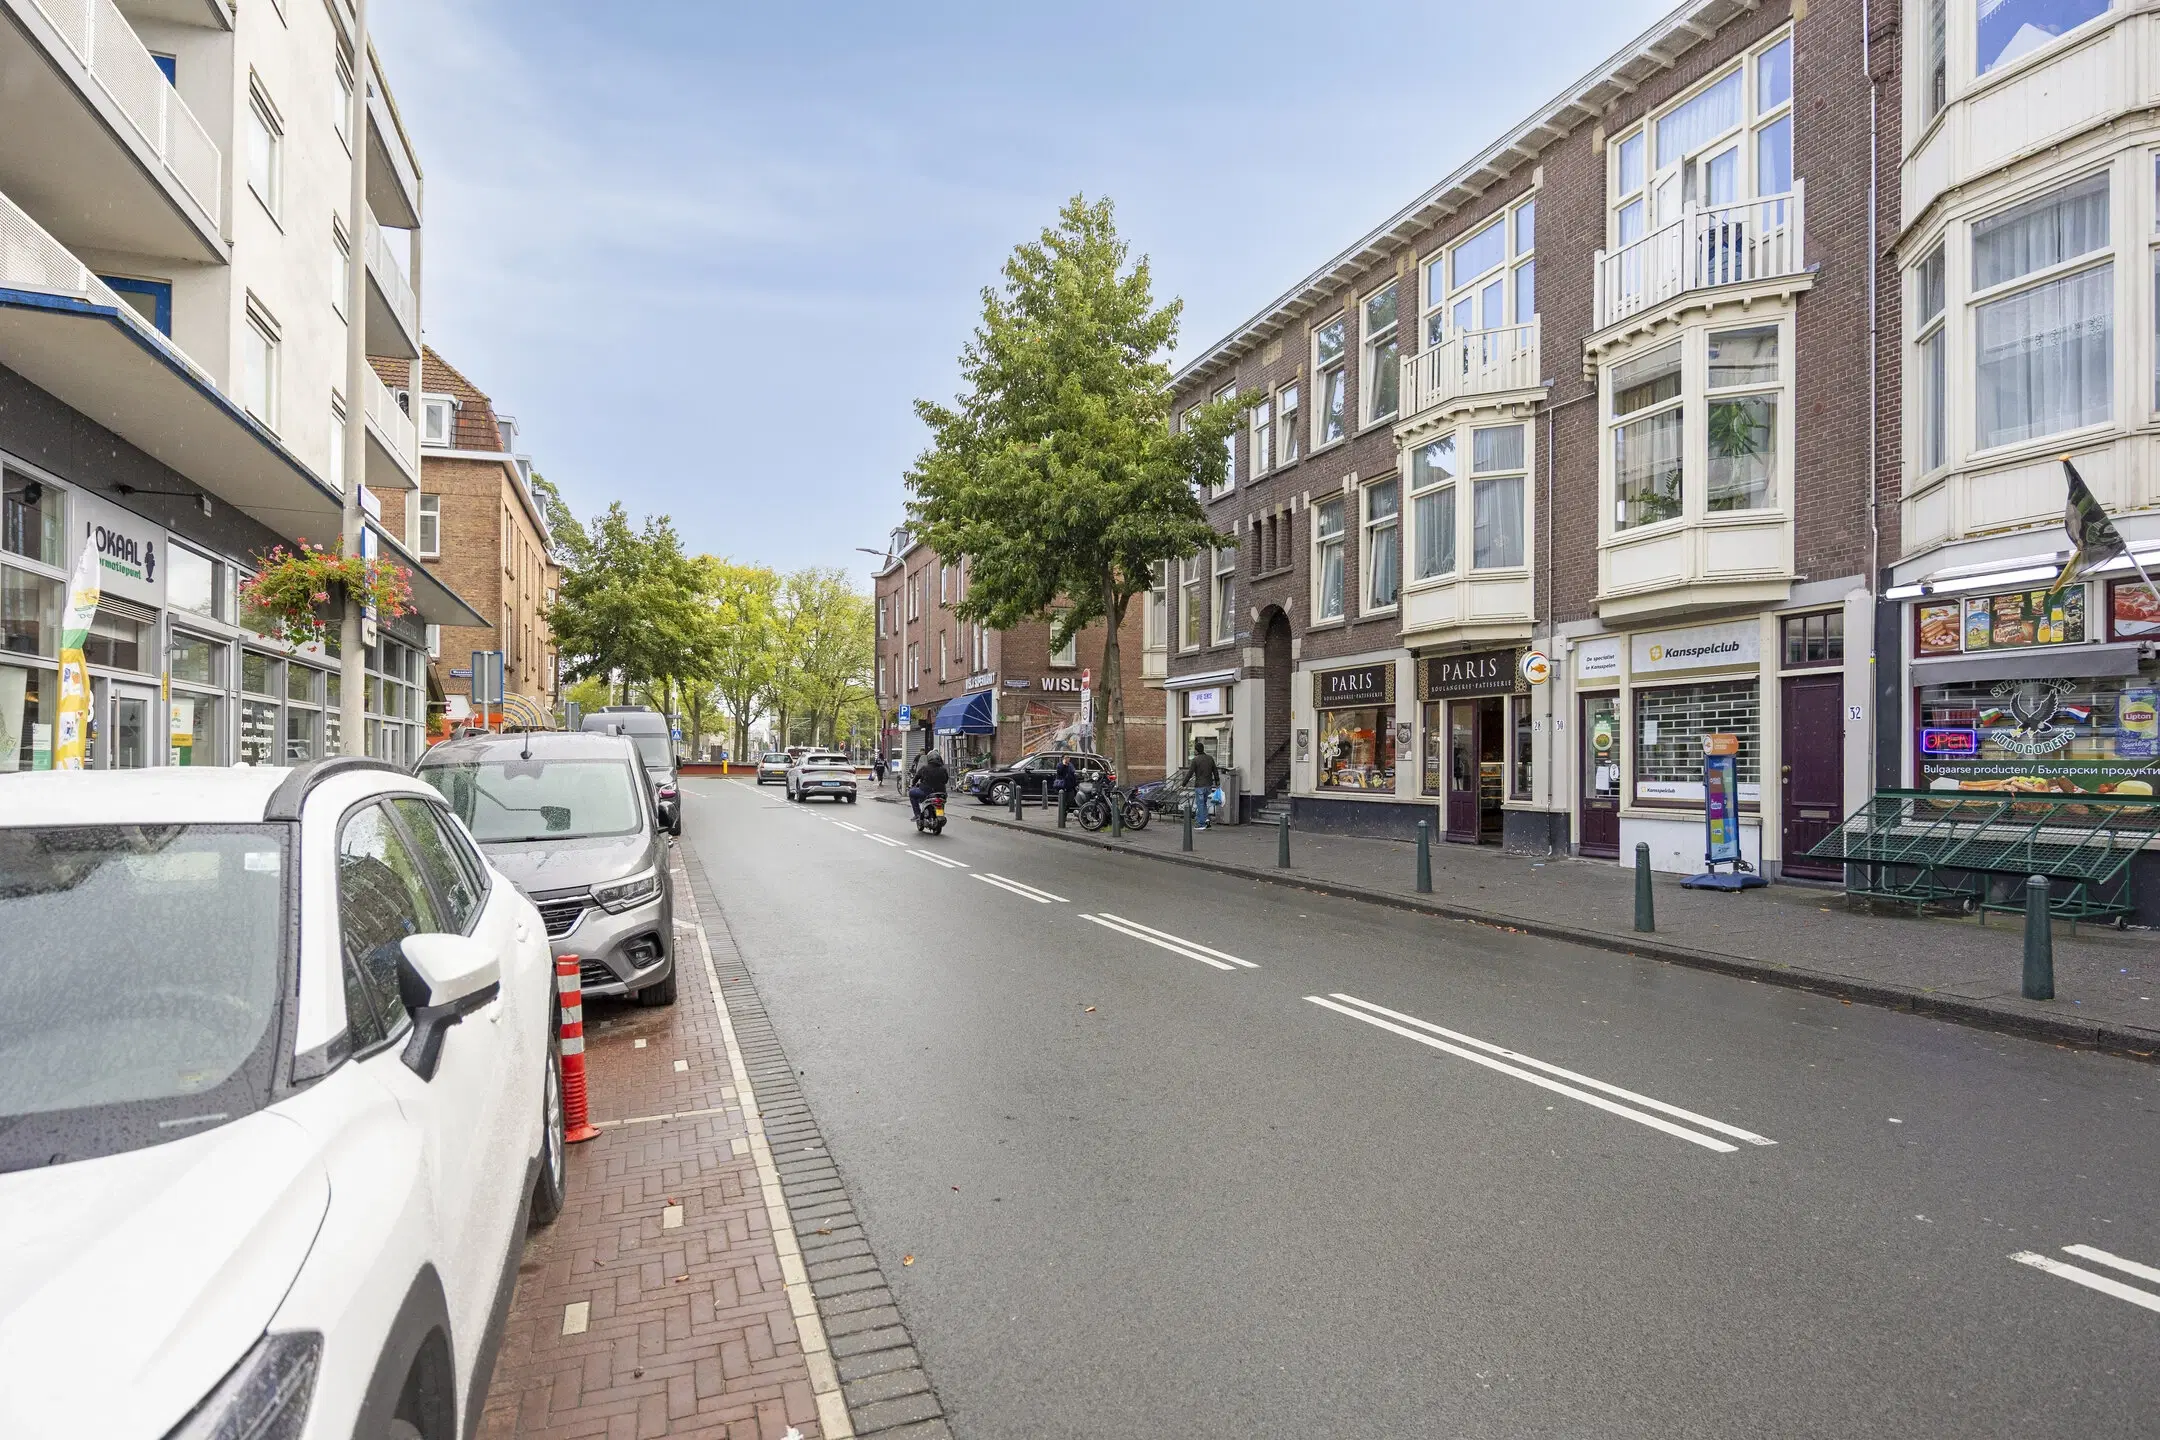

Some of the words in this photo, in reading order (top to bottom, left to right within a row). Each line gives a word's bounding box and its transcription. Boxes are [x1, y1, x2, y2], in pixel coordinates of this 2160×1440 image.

[1665, 641, 1740, 659] Kansspelclub
[1593, 654, 1615, 662] specialist
[1442, 657, 1497, 682] PARIS
[1590, 663, 1616, 671] Kansspelen
[1041, 677, 1084, 692] WISL
[1332, 672, 1373, 692] PARIS
[901, 706, 908, 715] P
[1849, 706, 1861, 720] 32
[2125, 713, 2152, 722] Lipton
[1925, 733, 1972, 749] OPEN
[1990, 728, 2077, 755] LUDOGORETS
[1923, 765, 1972, 775] Bulgaarse
[1973, 765, 2028, 775] producten
[2038, 765, 2098, 775] Български
[2101, 767, 2160, 777] продукти
